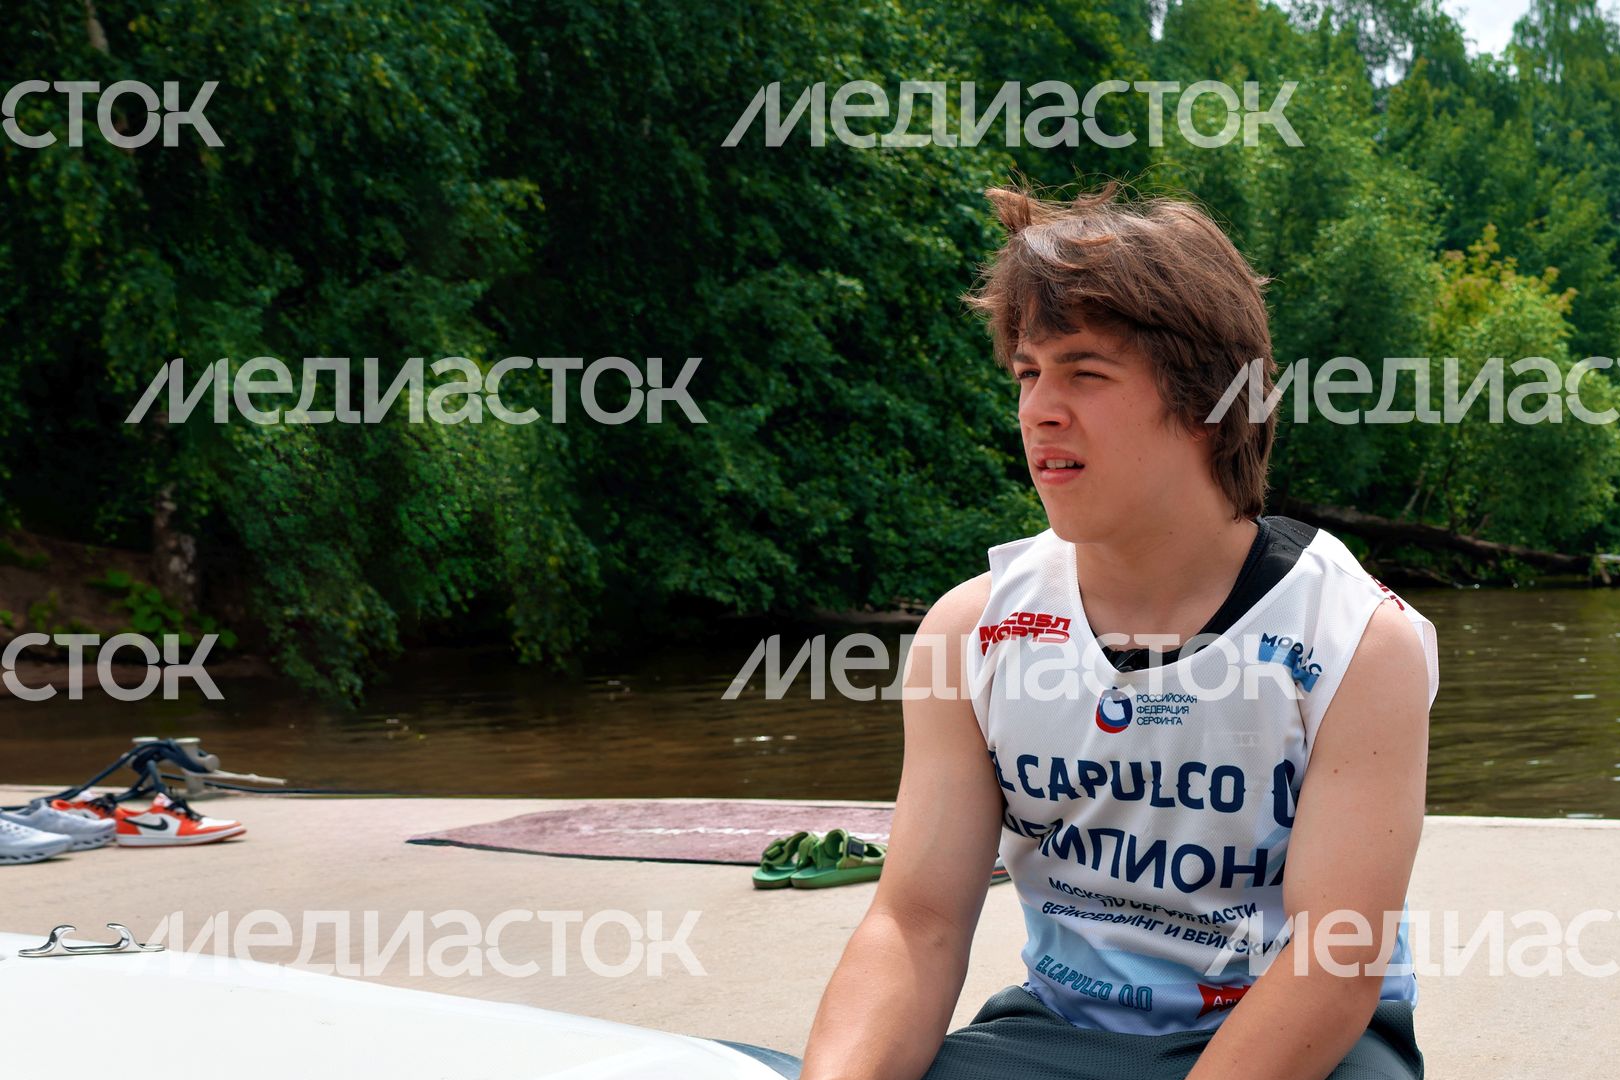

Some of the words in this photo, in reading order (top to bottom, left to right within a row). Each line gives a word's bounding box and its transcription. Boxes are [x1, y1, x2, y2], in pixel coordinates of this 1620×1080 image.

[1136, 705, 1189, 716] ФЕДЕРАЦИЯ
[1136, 717, 1183, 727] СЕРФИНГА
[1042, 901, 1164, 932] ВЕЙКСЕРФИНГ
[1164, 924, 1181, 938] И
